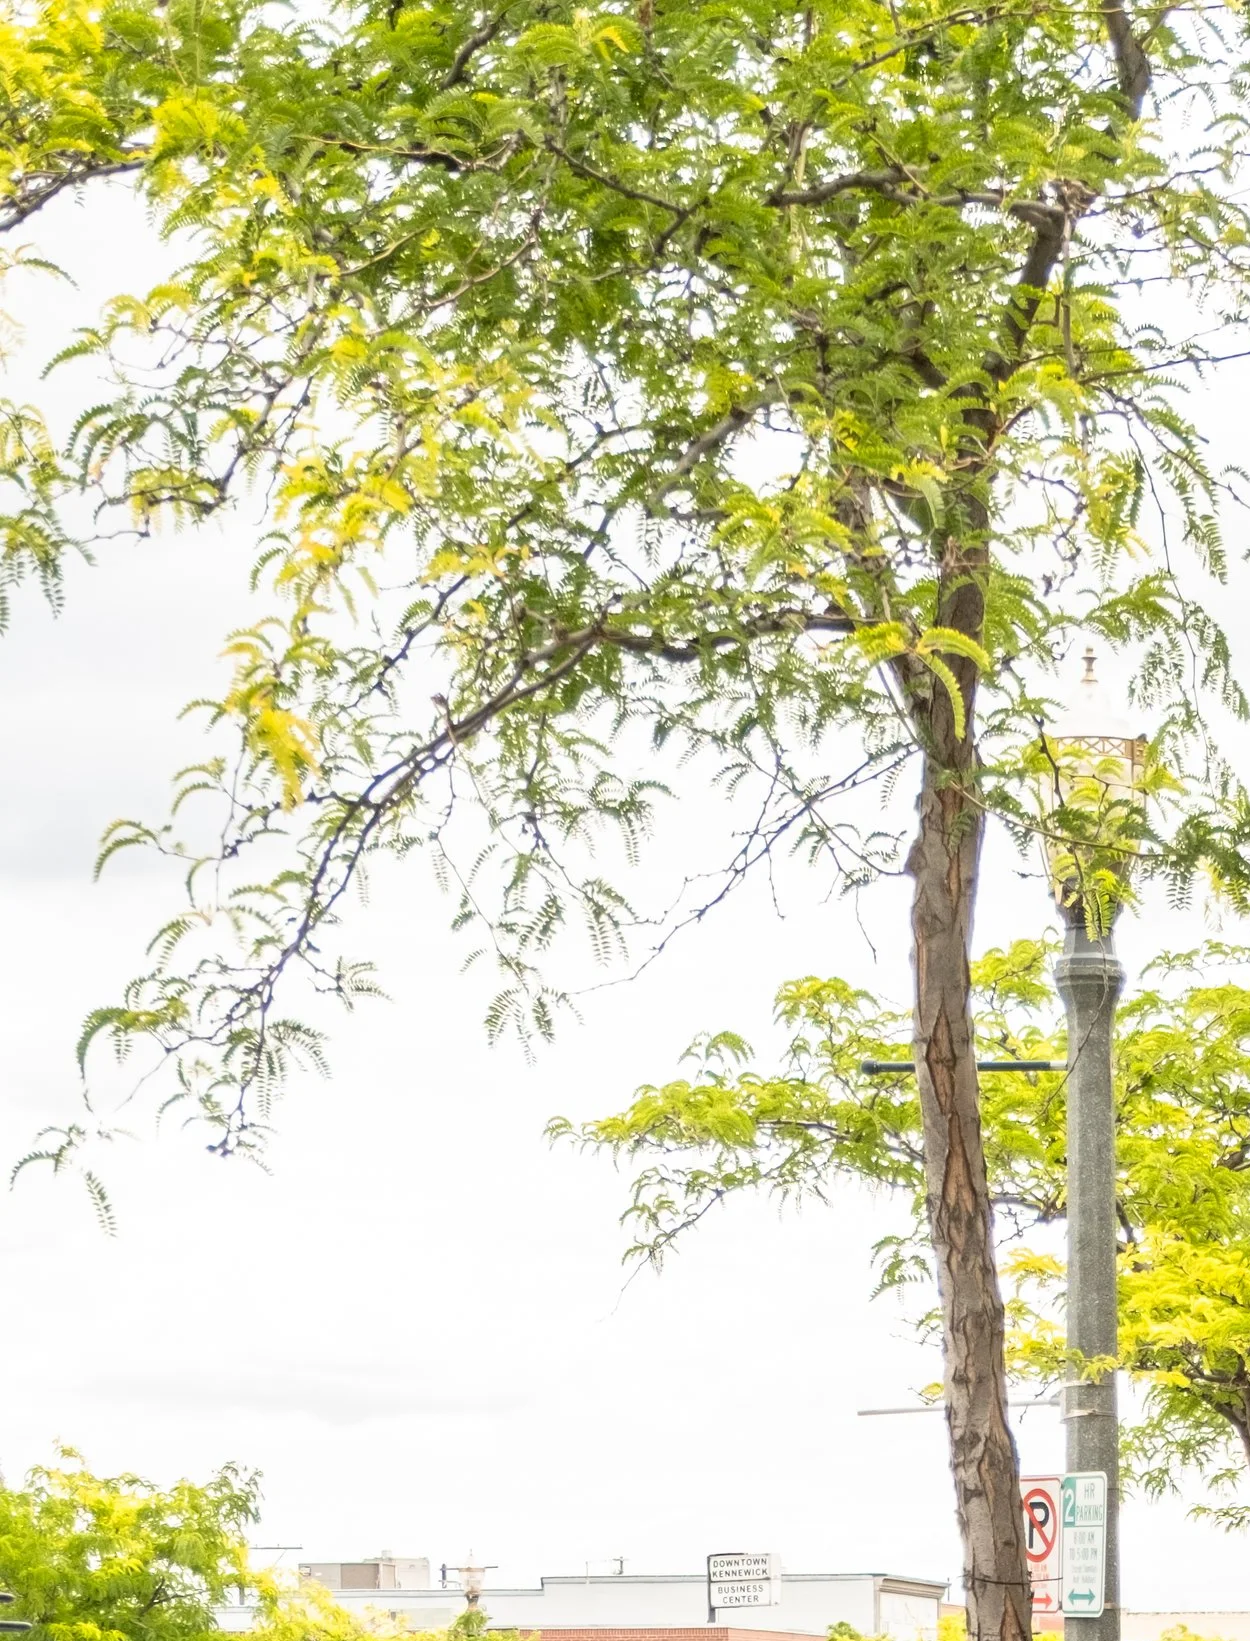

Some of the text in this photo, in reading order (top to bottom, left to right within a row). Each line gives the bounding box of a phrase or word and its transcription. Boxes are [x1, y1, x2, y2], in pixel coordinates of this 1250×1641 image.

[1083, 1482, 1096, 1499] HR
[1065, 1489, 1074, 1522] 2
[1076, 1504, 1103, 1522] PARKING
[713, 1558, 767, 1568] DOWNTOWN
[712, 1568, 768, 1578] KENNEWICK
[718, 1585, 763, 1594] BUSINESS
[723, 1595, 758, 1604] CENTER
